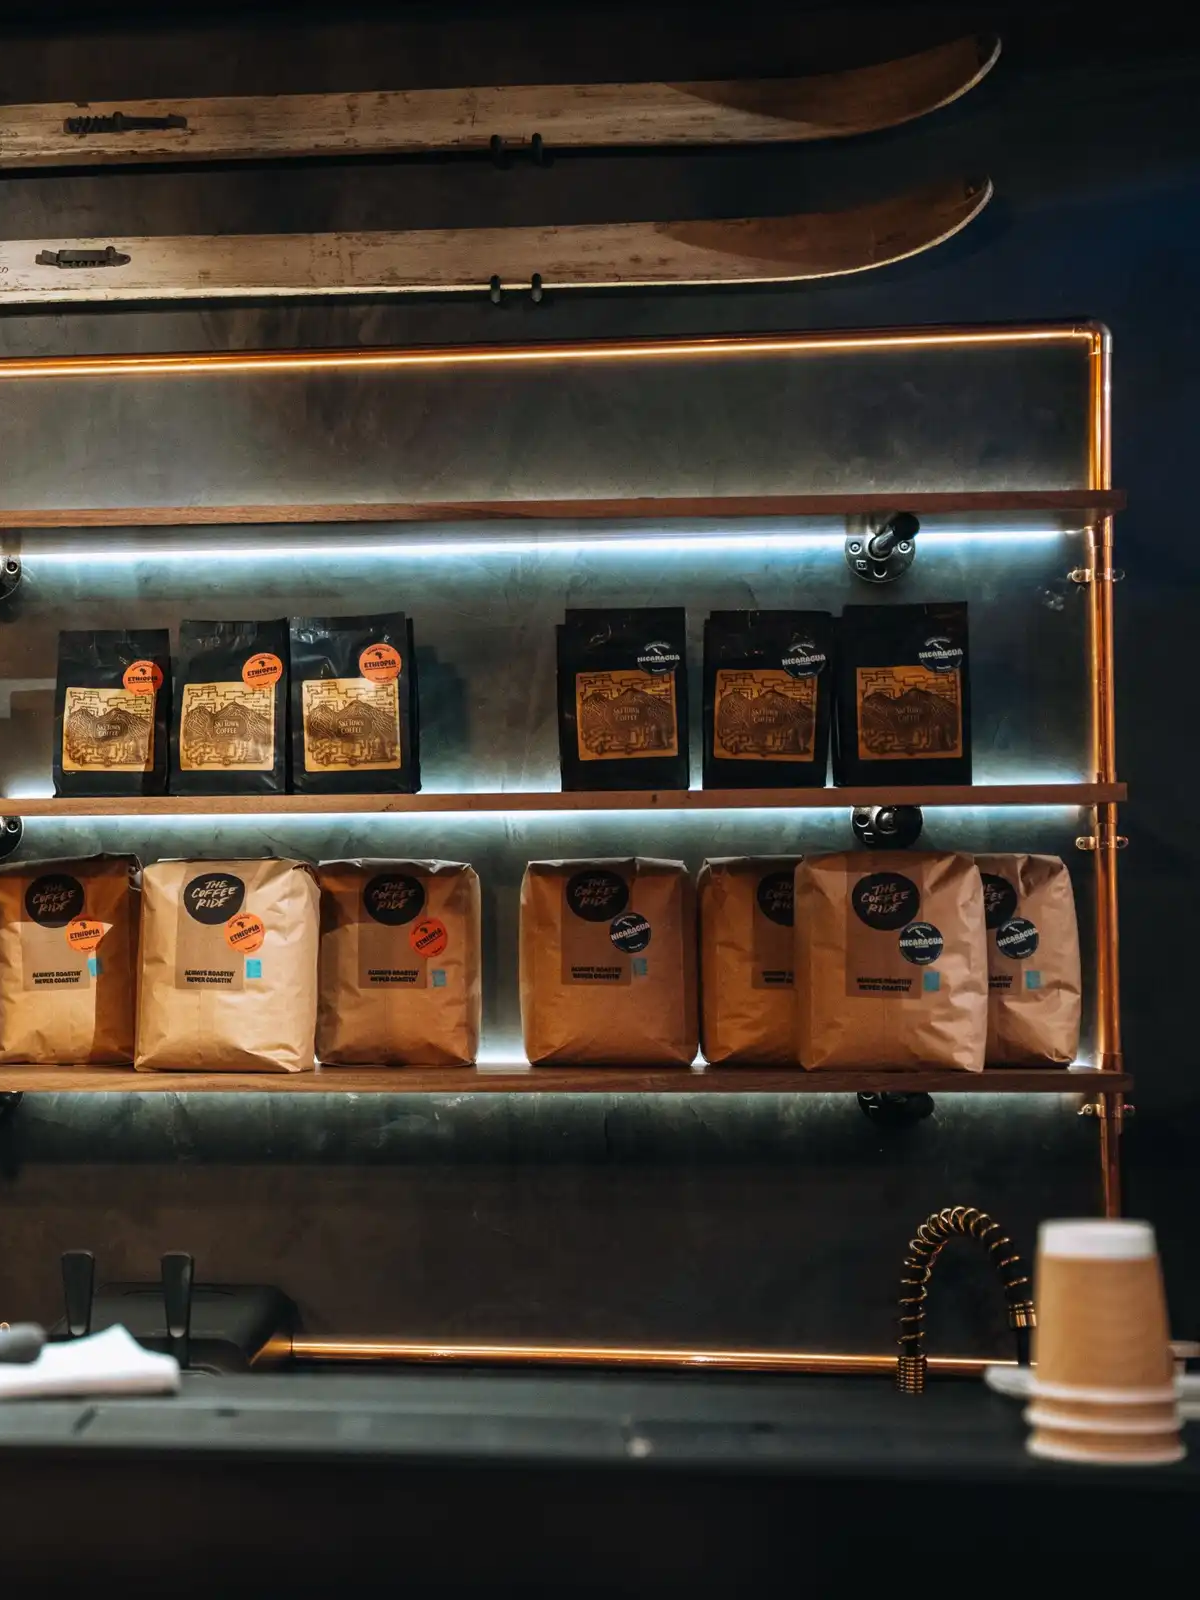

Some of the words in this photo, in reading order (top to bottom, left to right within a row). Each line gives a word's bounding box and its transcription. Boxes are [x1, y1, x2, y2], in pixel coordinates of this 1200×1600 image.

[637, 654, 680, 663] NICARAGUA
[782, 653, 826, 666] NICARAGUA
[918, 648, 963, 659] NICARAGUA
[363, 659, 397, 669] ETHIOPIA
[247, 665, 278, 677] ETHIOPIA
[205, 880, 228, 889] THE
[382, 881, 407, 891] THE
[872, 883, 897, 894] THE
[191, 886, 239, 899] COFFEE
[372, 888, 417, 900] COFFEE
[861, 891, 910, 903] COFFEE
[196, 897, 230, 910] RIDE
[376, 899, 409, 912] RIDE
[867, 902, 903, 915] RIDE
[69, 928, 100, 940] ETHIOPIA
[229, 924, 260, 942] ETHIOPIA
[610, 922, 650, 941] NICARAGUA
[997, 927, 1038, 947] NICARAGUA
[415, 927, 443, 949] ETHIOPIA
[899, 937, 943, 948] NICARAGUA
